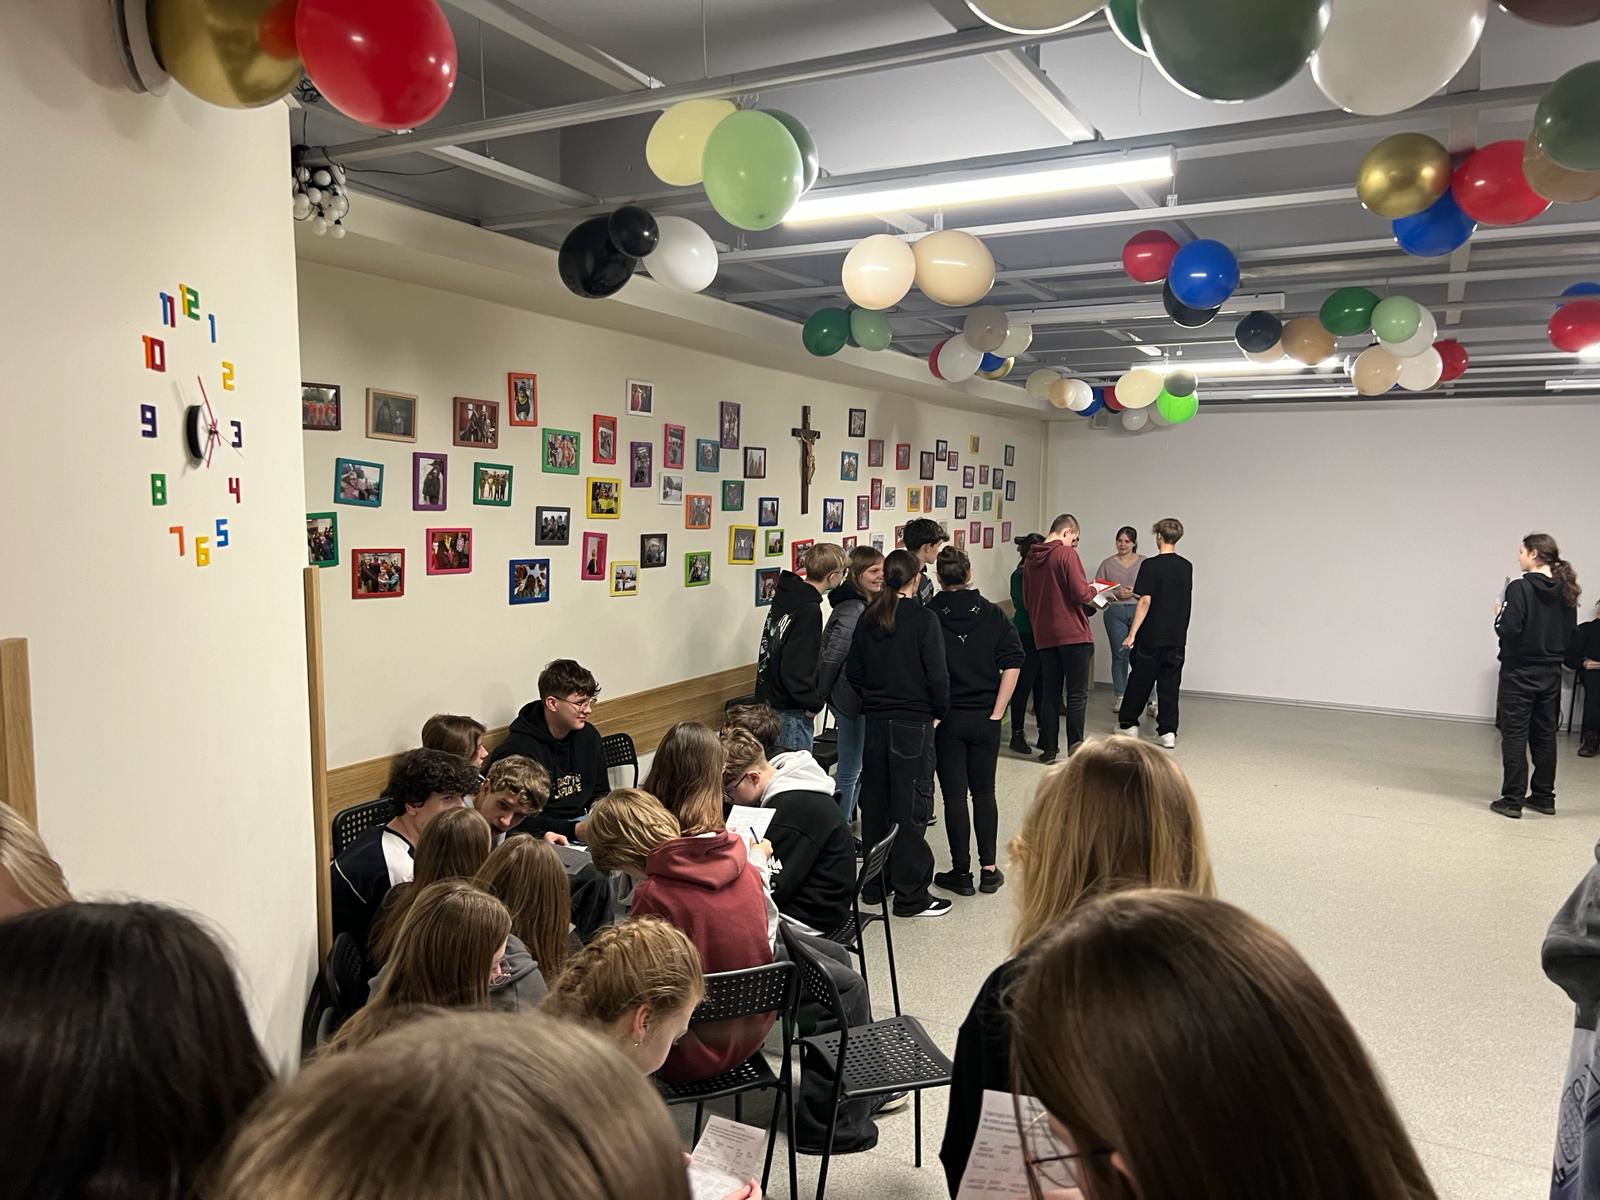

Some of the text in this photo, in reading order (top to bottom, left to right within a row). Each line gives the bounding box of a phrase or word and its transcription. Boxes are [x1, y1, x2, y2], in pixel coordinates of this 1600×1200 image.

[160, 292, 176, 328] 11
[179, 284, 200, 320] 12
[208, 314, 216, 343] 1
[142, 335, 166, 372] 10
[222, 361, 235, 391] 2
[141, 404, 157, 438] 9
[230, 420, 242, 448] 3
[151, 473, 167, 506] 8
[228, 477, 241, 504] 4
[169, 526, 185, 557] 7
[216, 519, 229, 547] 5
[195, 536, 210, 567] 6
